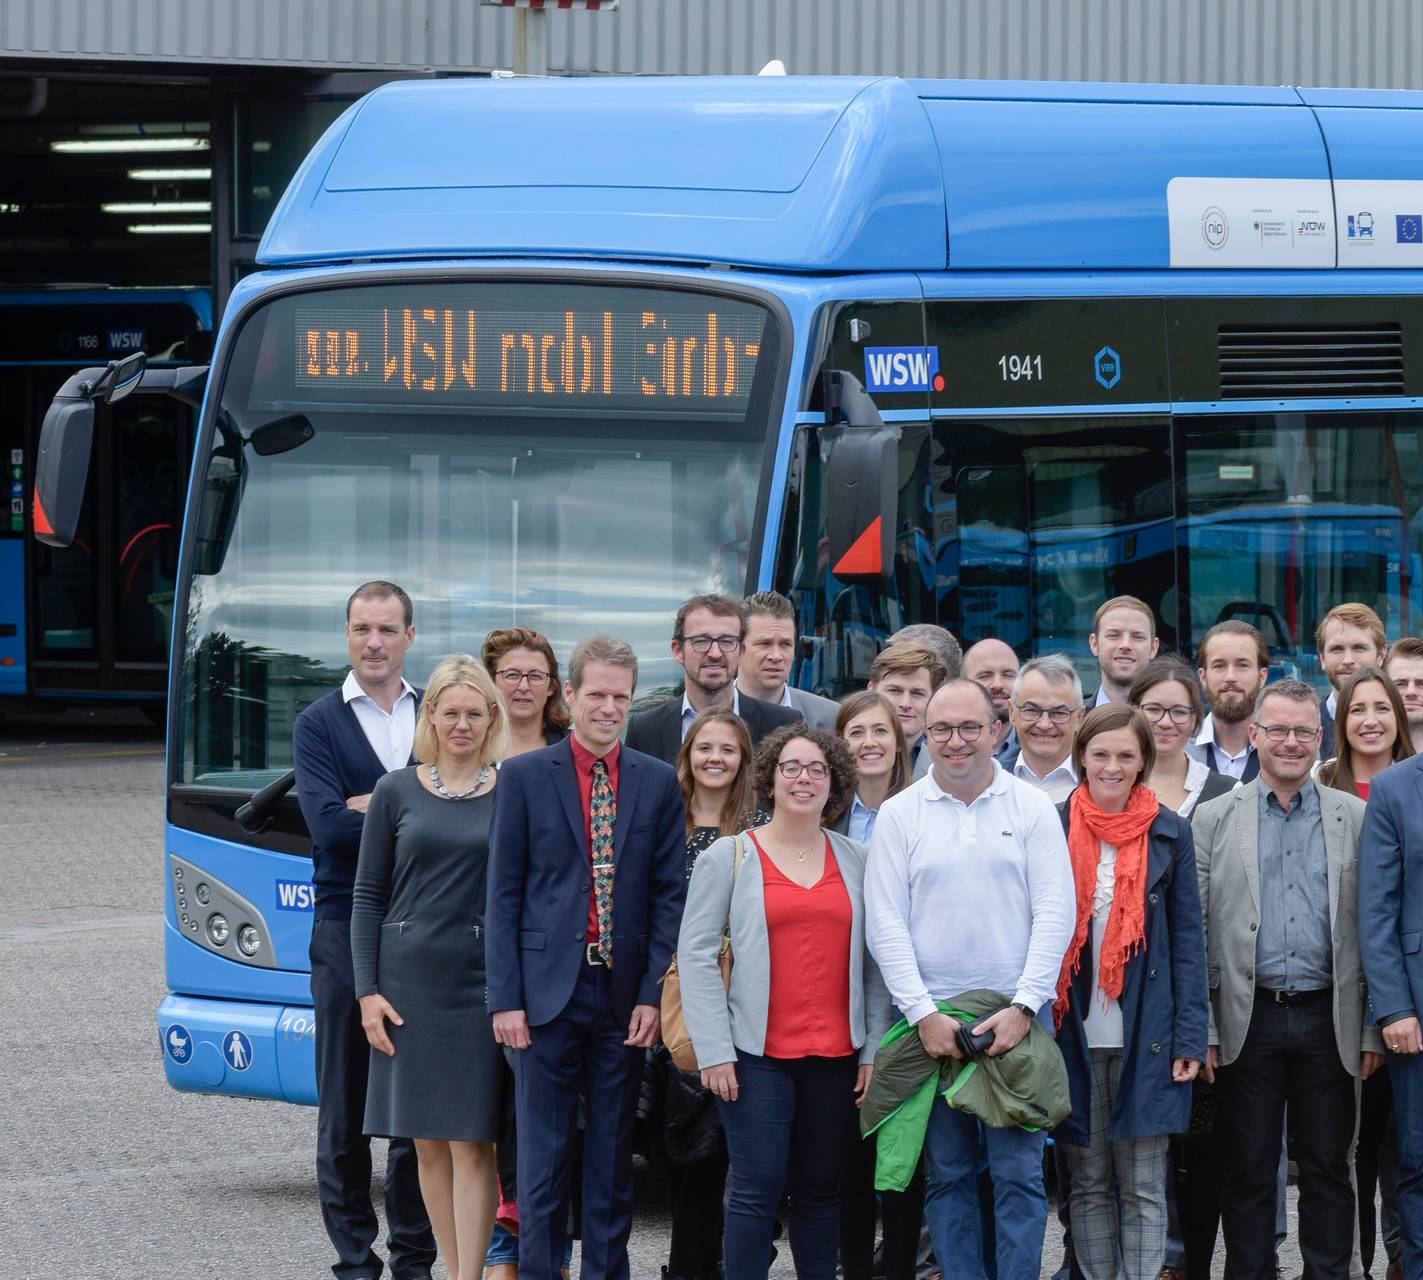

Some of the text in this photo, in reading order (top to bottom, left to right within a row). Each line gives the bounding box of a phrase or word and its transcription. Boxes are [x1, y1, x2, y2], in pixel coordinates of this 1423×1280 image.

[110, 332, 143, 348] WSW
[868, 352, 930, 386] WSW
[998, 354, 1043, 382] 1941
